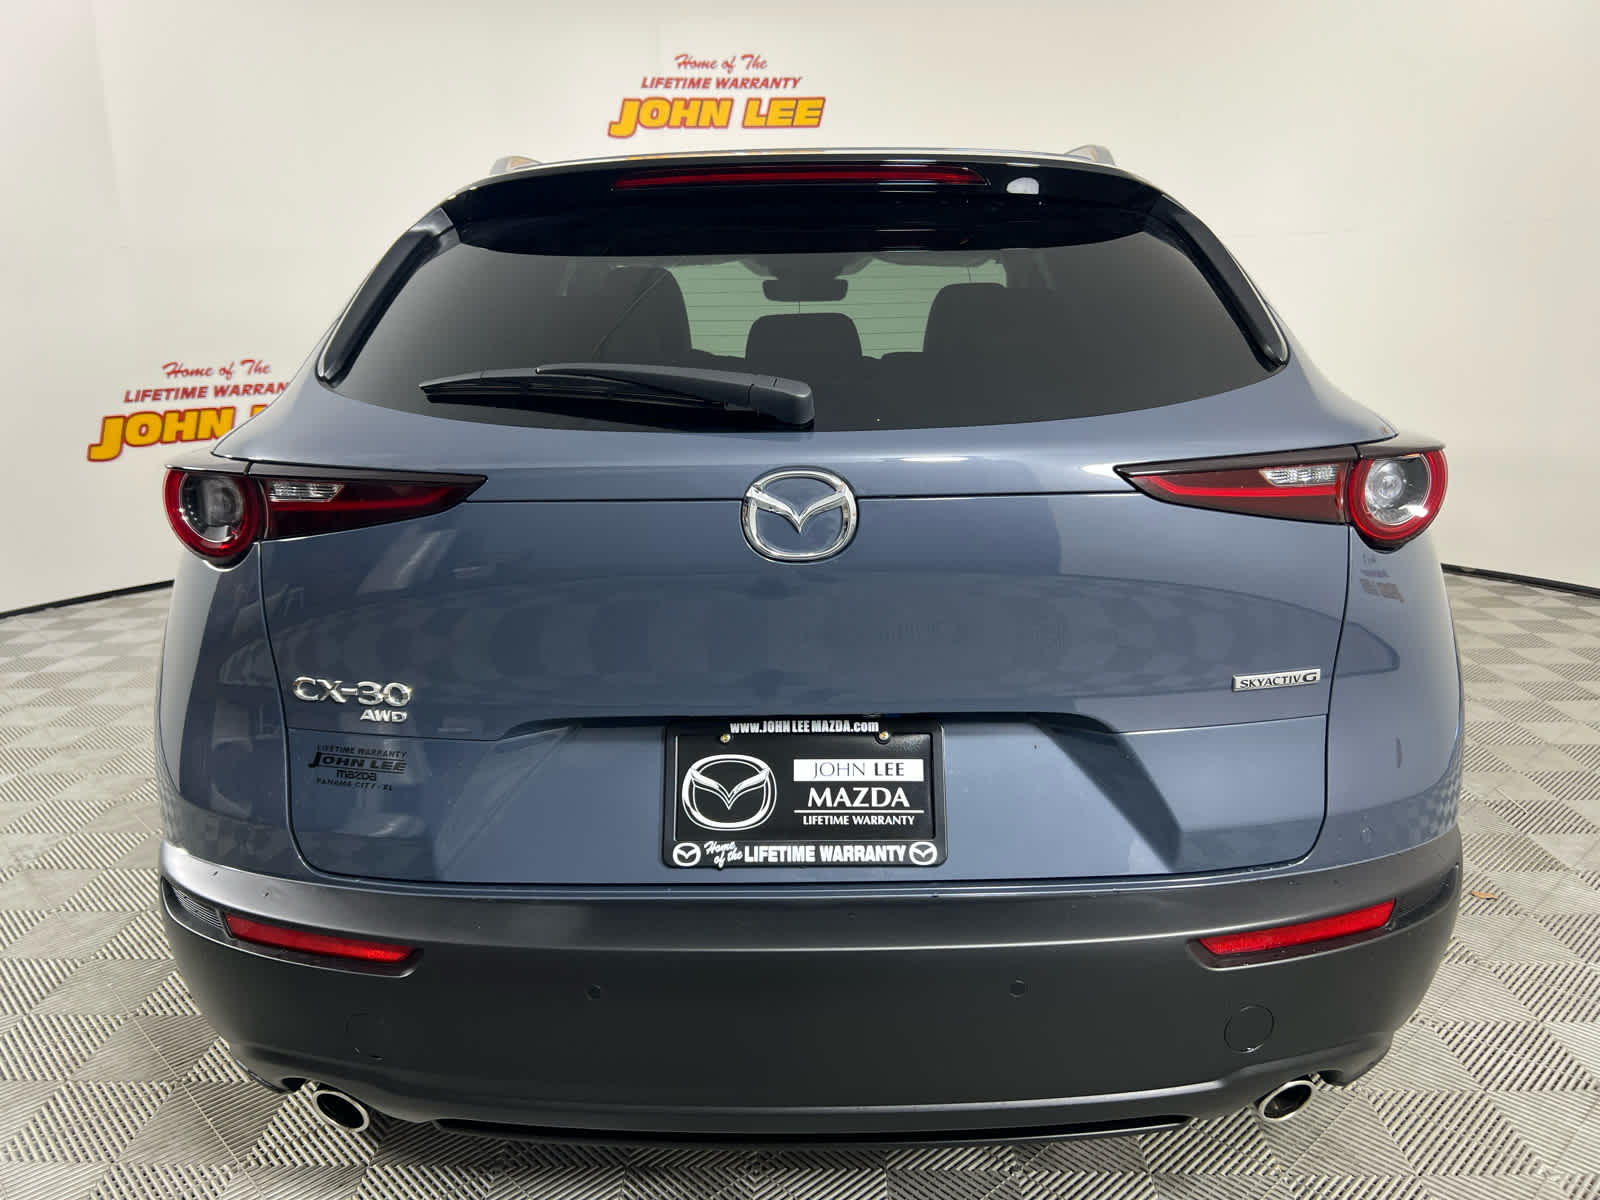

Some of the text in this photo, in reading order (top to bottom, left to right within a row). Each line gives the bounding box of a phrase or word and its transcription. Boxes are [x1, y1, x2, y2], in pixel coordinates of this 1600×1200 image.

[674, 53, 768, 74] Home of The
[640, 76, 801, 89] LIFETIME WARRANTY
[608, 96, 826, 139] JOHN LEE
[162, 359, 271, 380] Home of The
[123, 382, 290, 403] LIFETIME WARRAN
[86, 406, 236, 462] JOHN
[293, 676, 412, 706] CX-30
[360, 709, 408, 722] AWD
[792, 720, 810, 732] LEE
[317, 744, 407, 759] LIFETIME WARRANTY
[308, 752, 407, 771] JOHN LEE
[814, 762, 904, 778] JOHN LEE
[808, 787, 910, 807] MAZDA
[803, 815, 915, 825] LIFETIME WARRANTY
[704, 840, 736, 855] Home
[744, 845, 906, 862] LIFETIME WARRANTY
[714, 848, 743, 868] of the
